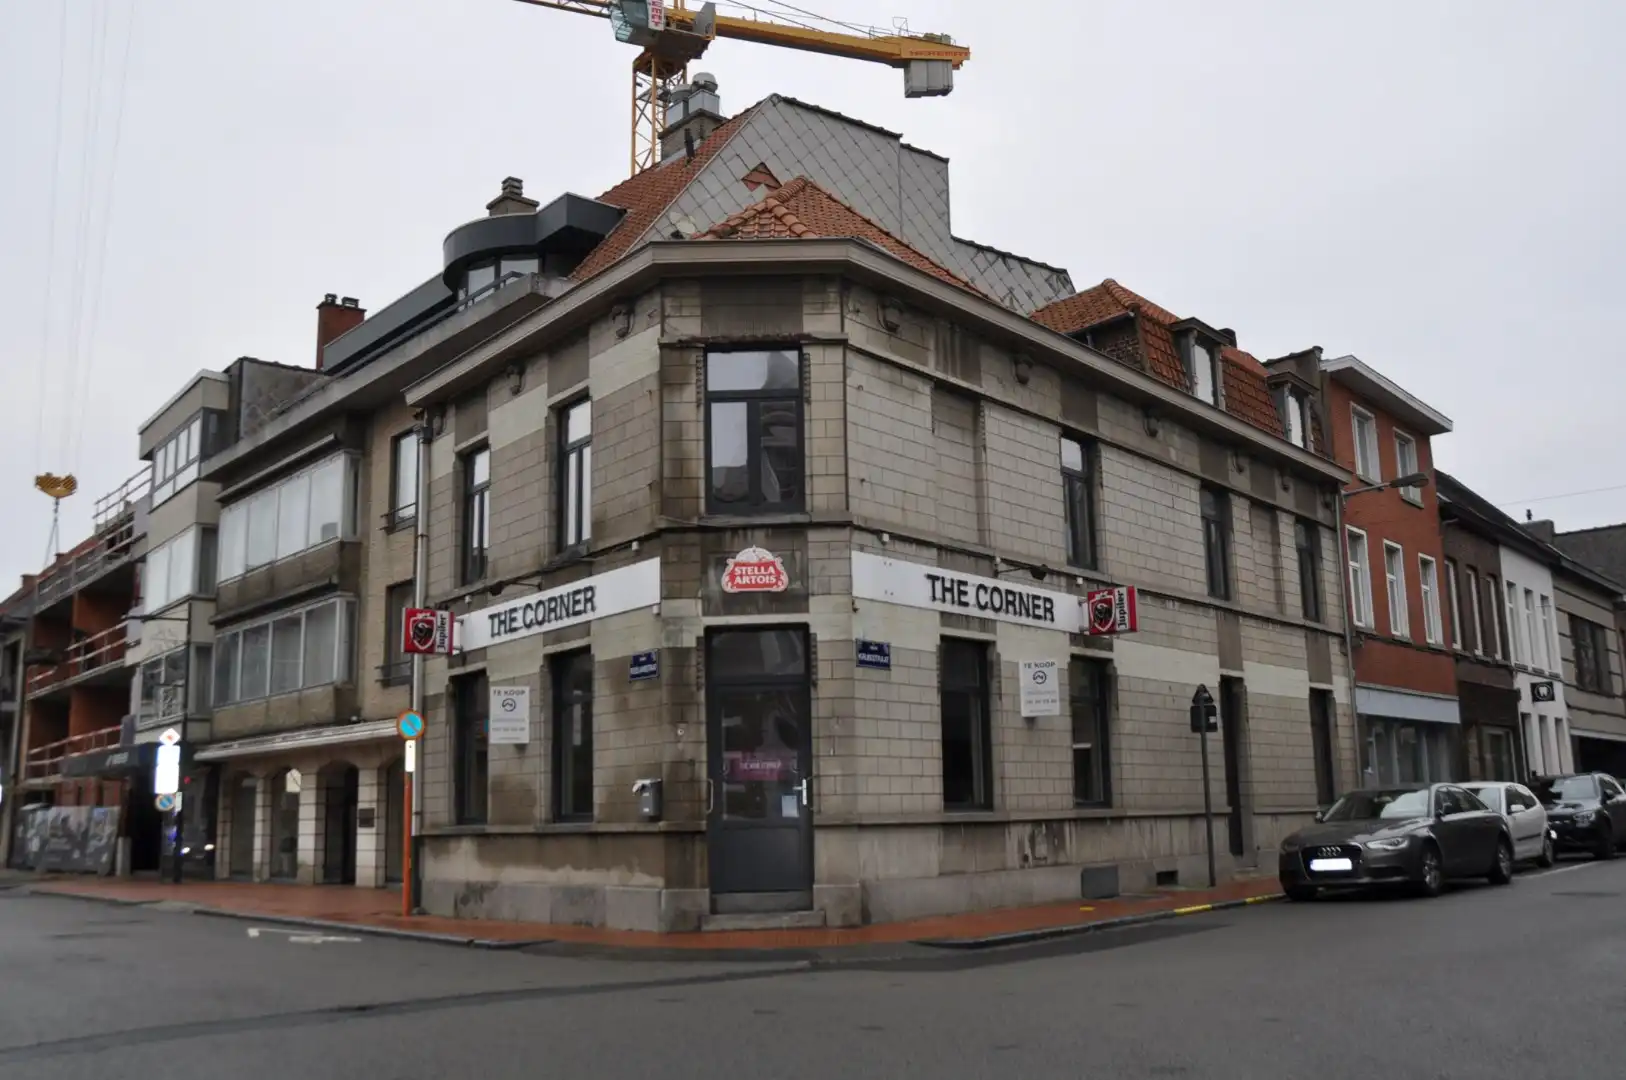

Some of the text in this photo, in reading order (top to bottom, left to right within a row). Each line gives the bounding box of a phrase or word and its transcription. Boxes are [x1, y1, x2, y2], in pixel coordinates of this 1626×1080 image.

[734, 565, 776, 576] STELLA
[734, 575, 777, 585] ARTOIS
[488, 585, 597, 638] THE CORNER
[925, 572, 1055, 623] THE CORNER
[1116, 589, 1128, 629] Jupiler
[437, 614, 448, 650] Jupiler
[1034, 660, 1056, 669] KOOP
